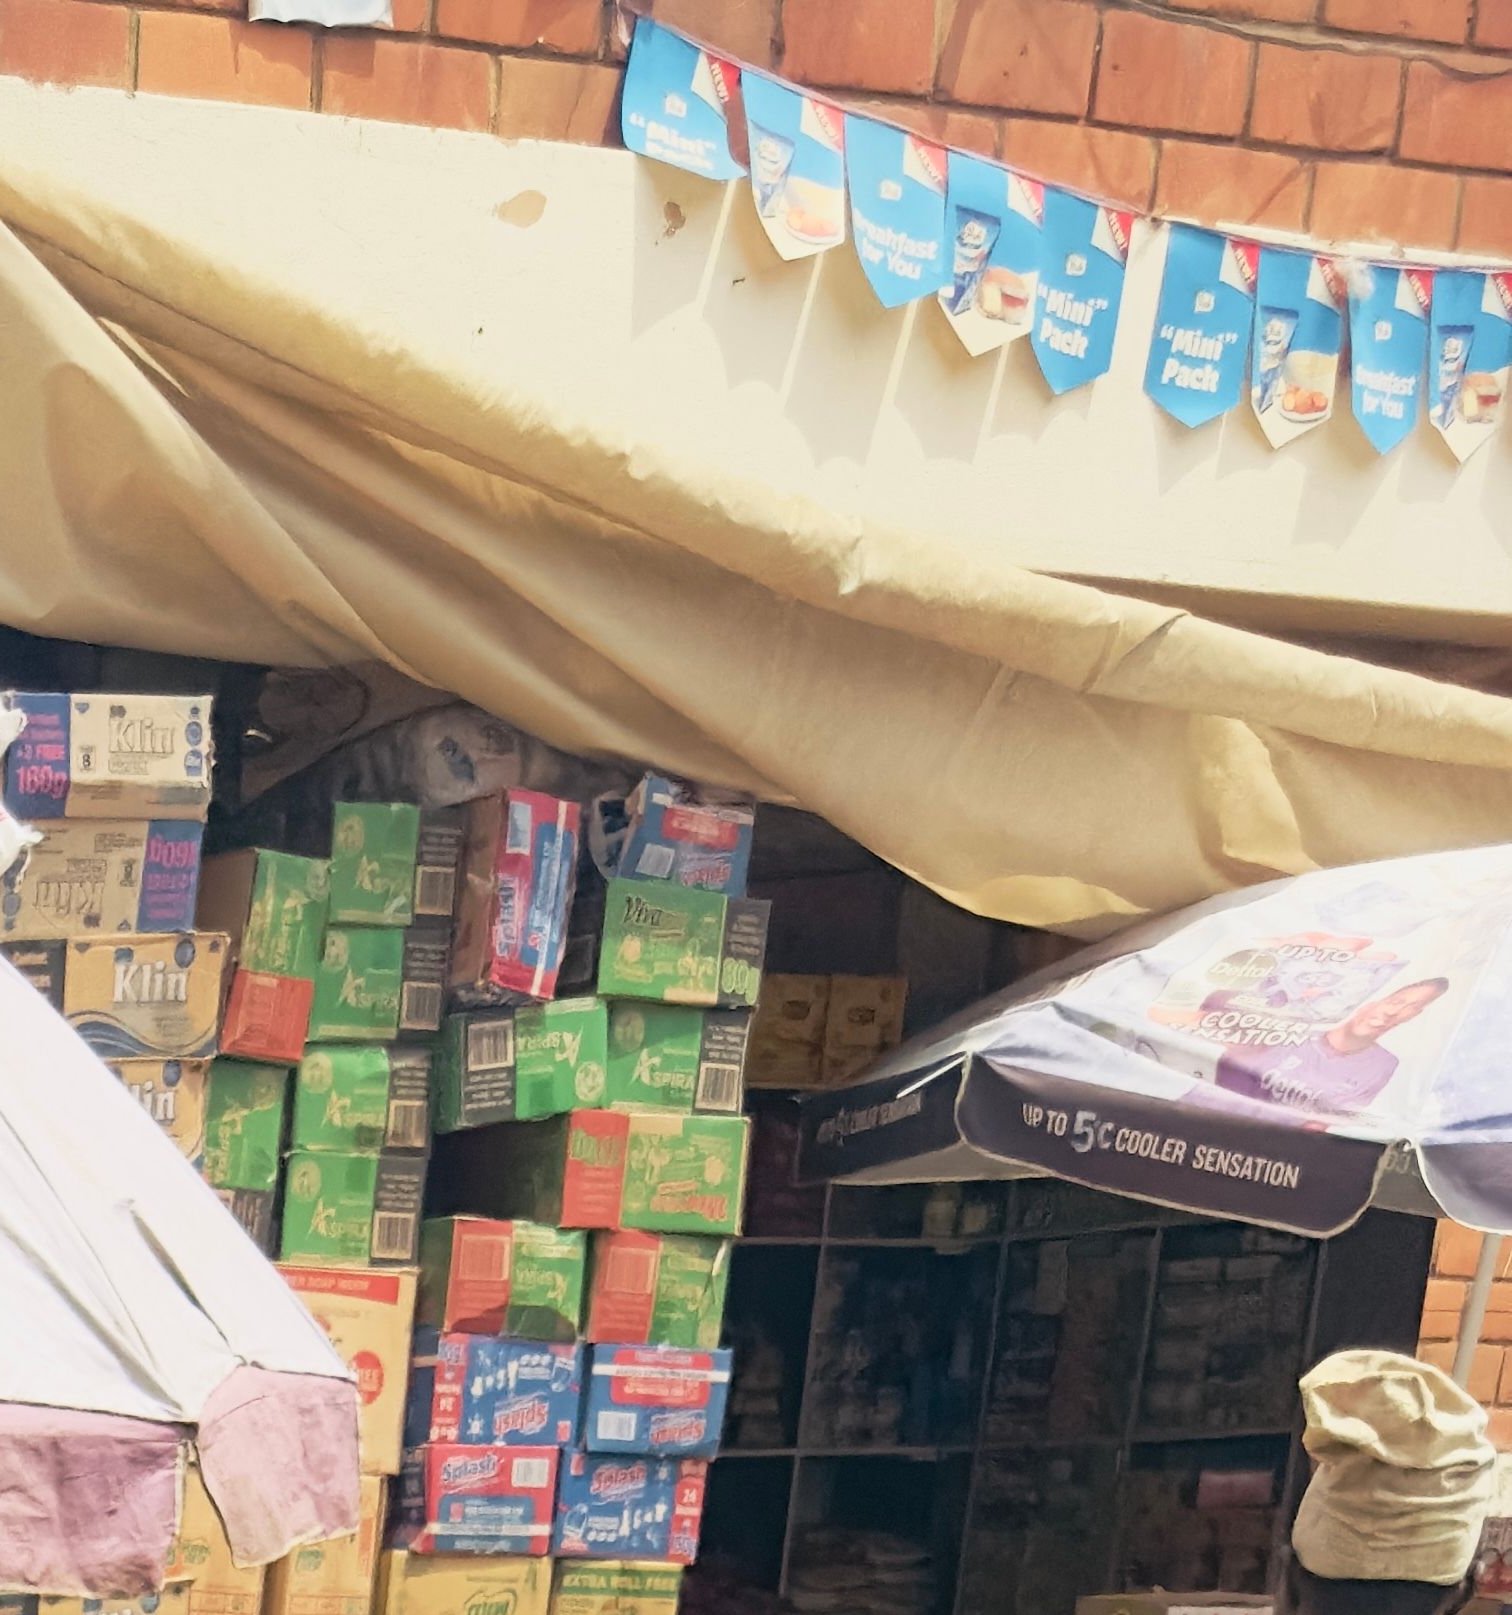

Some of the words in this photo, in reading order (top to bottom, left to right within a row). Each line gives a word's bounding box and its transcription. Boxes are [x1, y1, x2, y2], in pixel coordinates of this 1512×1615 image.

[1161, 358, 1220, 393] Pack
[109, 717, 175, 754] Klin
[113, 961, 188, 1004] Klin
[1201, 1010, 1311, 1035] COOLER
[1022, 1103, 1043, 1127] UP
[1046, 1110, 1067, 1137] TO
[1114, 1128, 1187, 1165] COOLER
[1192, 1145, 1300, 1189] SENSATION
